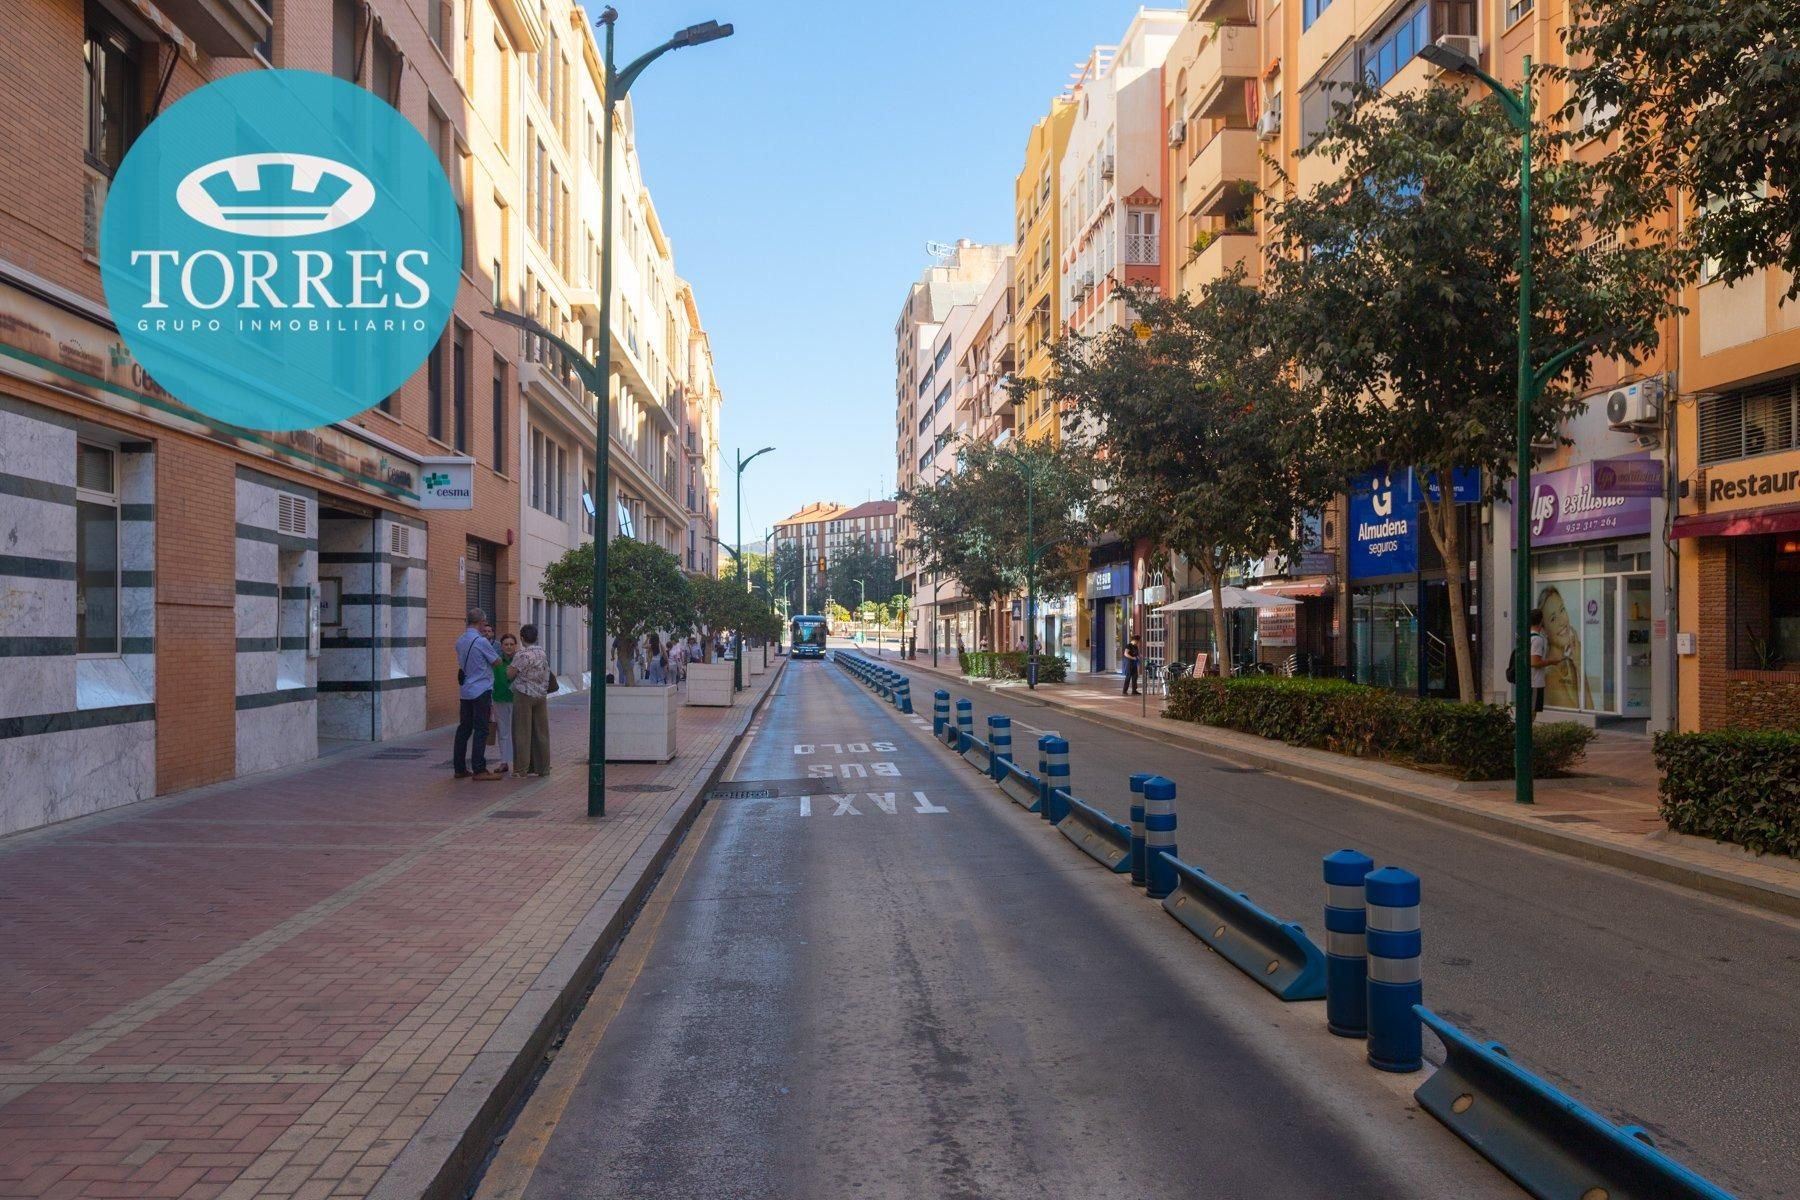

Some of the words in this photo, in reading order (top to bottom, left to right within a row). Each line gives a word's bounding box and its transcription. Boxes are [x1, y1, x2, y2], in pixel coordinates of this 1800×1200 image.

[436, 489, 469, 497] cesma
[1428, 483, 1464, 492] Almena
[1709, 470, 1800, 502] Restaur
[1358, 518, 1408, 541] Almudena
[1566, 523, 1581, 534] 952
[1583, 520, 1598, 531] 317
[1600, 517, 1617, 528] 264
[1368, 540, 1398, 557] seguros
[794, 741, 898, 754] SOLO
[807, 762, 902, 779] BUS
[800, 791, 949, 817] TAXI
